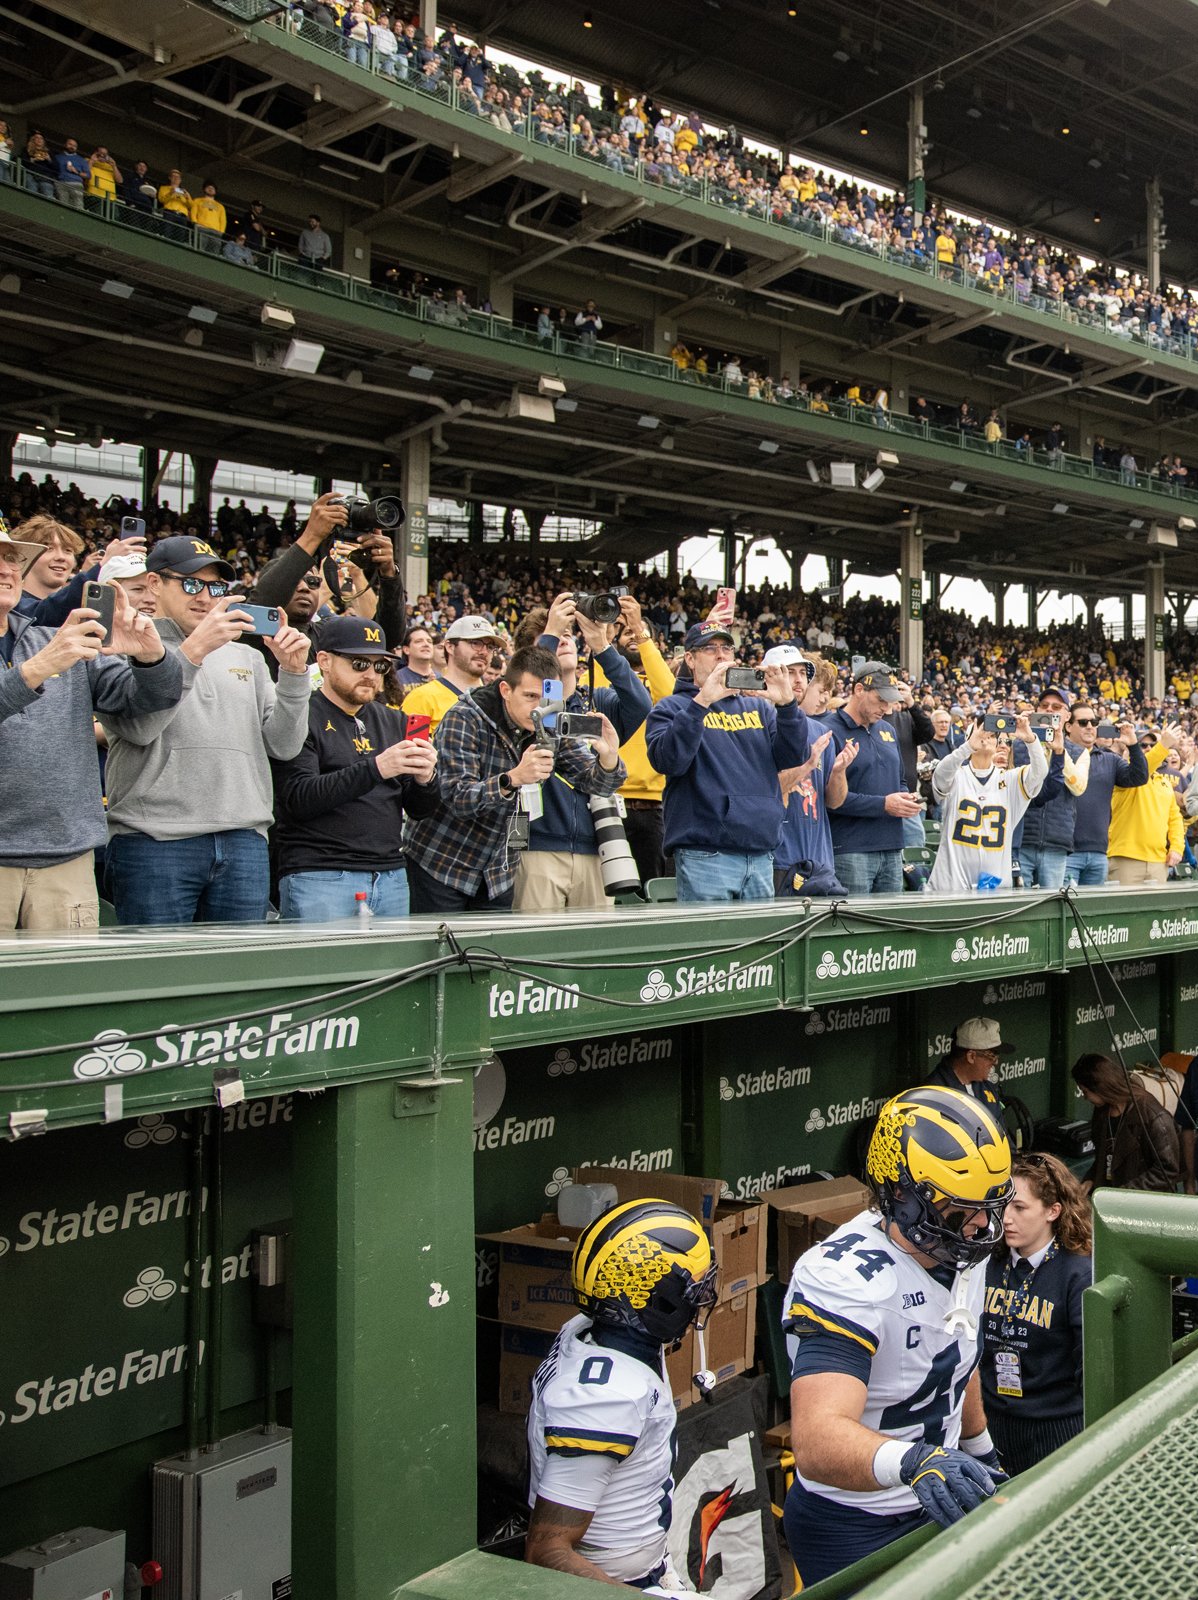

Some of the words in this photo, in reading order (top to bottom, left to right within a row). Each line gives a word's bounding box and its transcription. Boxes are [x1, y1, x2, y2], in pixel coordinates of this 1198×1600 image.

[411, 517, 425, 528] 223
[410, 533, 425, 544] 222
[191, 541, 216, 558] M
[364, 628, 381, 643] M
[952, 798, 1007, 851] 23
[820, 1232, 896, 1282] 44
[988, 1319, 997, 1331] 20
[1017, 1326, 1028, 1337] 23
[906, 1325, 921, 1350] C
[578, 1356, 614, 1386] 0
